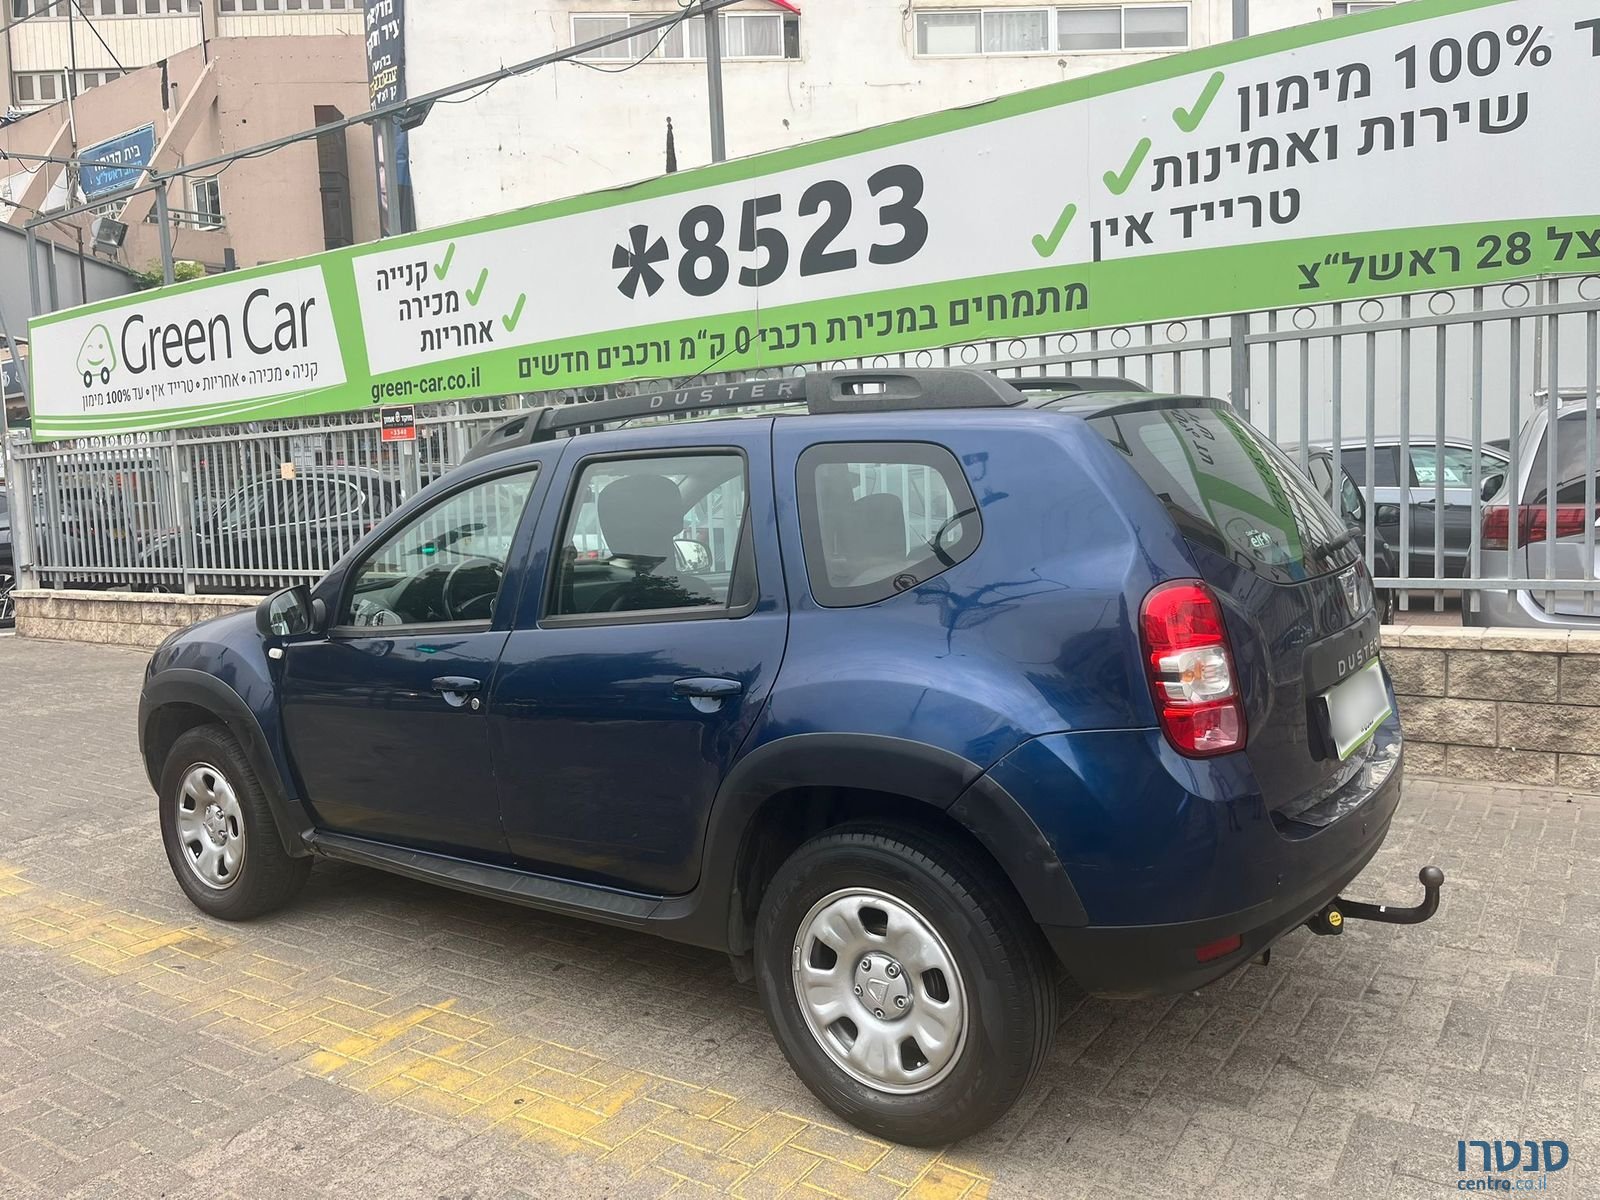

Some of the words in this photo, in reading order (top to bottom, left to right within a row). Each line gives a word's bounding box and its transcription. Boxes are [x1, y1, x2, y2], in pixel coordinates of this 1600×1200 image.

[1394, 24, 1552, 89] 100%
[1237, 62, 1371, 132] מימון
[1357, 92, 1528, 156] שירות
[124, 145, 141, 161] בית
[1151, 124, 1338, 192] ואמינות
[1170, 188, 1300, 238] טרייד
[1090, 211, 1154, 262] אין
[1476, 231, 1531, 269] 28
[1547, 226, 1600, 261] צל
[376, 261, 428, 291] קנייה
[1297, 246, 1460, 289] ראשל"צ
[399, 290, 459, 321] מכירה
[950, 282, 1088, 326] מתמחים
[121, 313, 232, 374] Green
[242, 288, 316, 354] Car
[420, 320, 494, 352] אחריות
[759, 321, 817, 351] רכבי
[826, 304, 938, 343] במכירת
[598, 340, 670, 369] ורכבים
[680, 329, 725, 360] ק"מ
[249, 367, 282, 384] מכירה
[293, 361, 318, 381] קניה
[519, 350, 589, 378] חדשים
[106, 388, 131, 404] 100%
[132, 387, 143, 400] עד
[151, 383, 164, 401] אין
[167, 379, 194, 395] טרייד
[203, 372, 239, 391] אחריות
[371, 367, 480, 403] green-car.co.il
[650, 383, 793, 408] DUSTER
[82, 393, 103, 411] מימון
[1338, 638, 1378, 676] DUSTER
